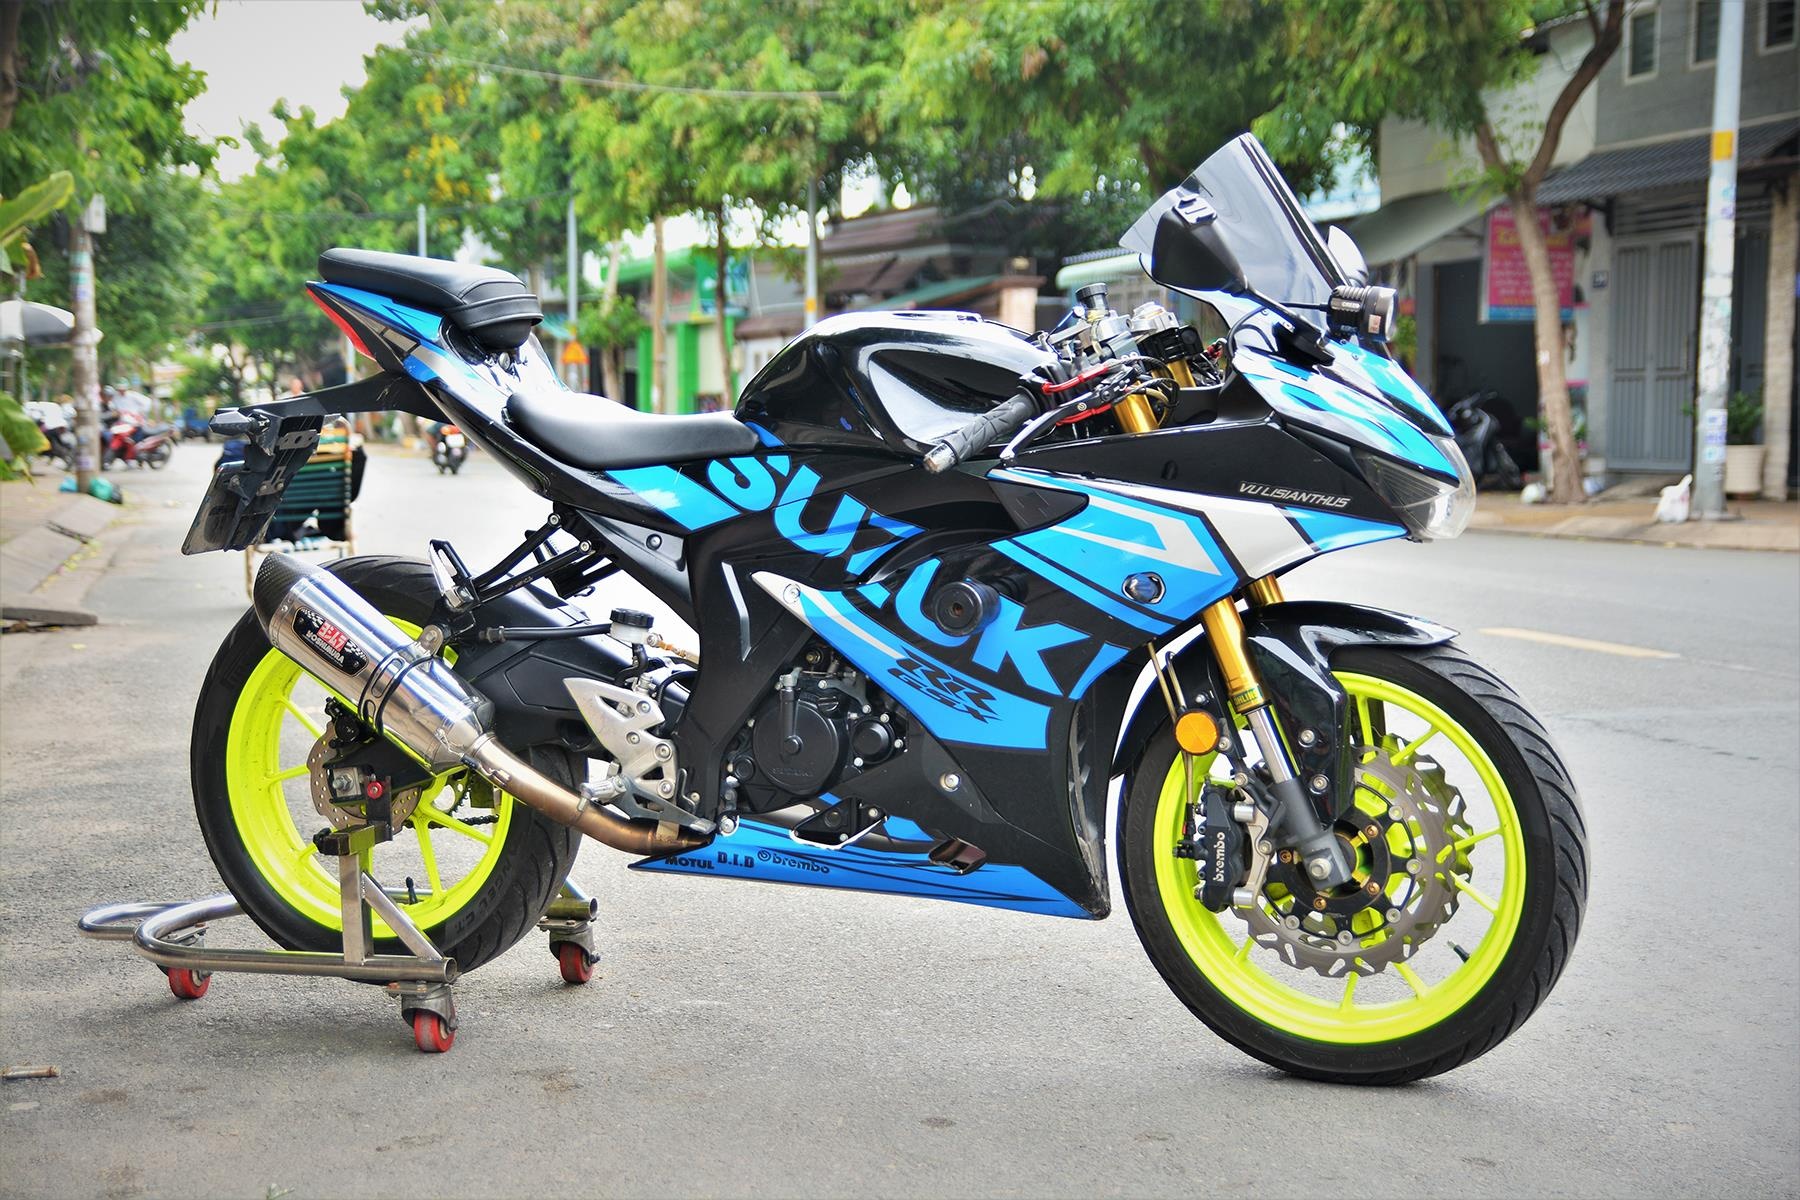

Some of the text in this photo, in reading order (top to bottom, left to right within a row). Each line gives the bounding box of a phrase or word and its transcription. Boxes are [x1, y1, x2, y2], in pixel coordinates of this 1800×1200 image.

[1240, 482, 1351, 508] VU LISIANTHUS
[707, 455, 1130, 700] SUZUKI
[305, 630, 345, 664] YOSHIMURA
[665, 852, 831, 874] MOTUL D.I.D brembo
[1212, 831, 1226, 882] brembo
